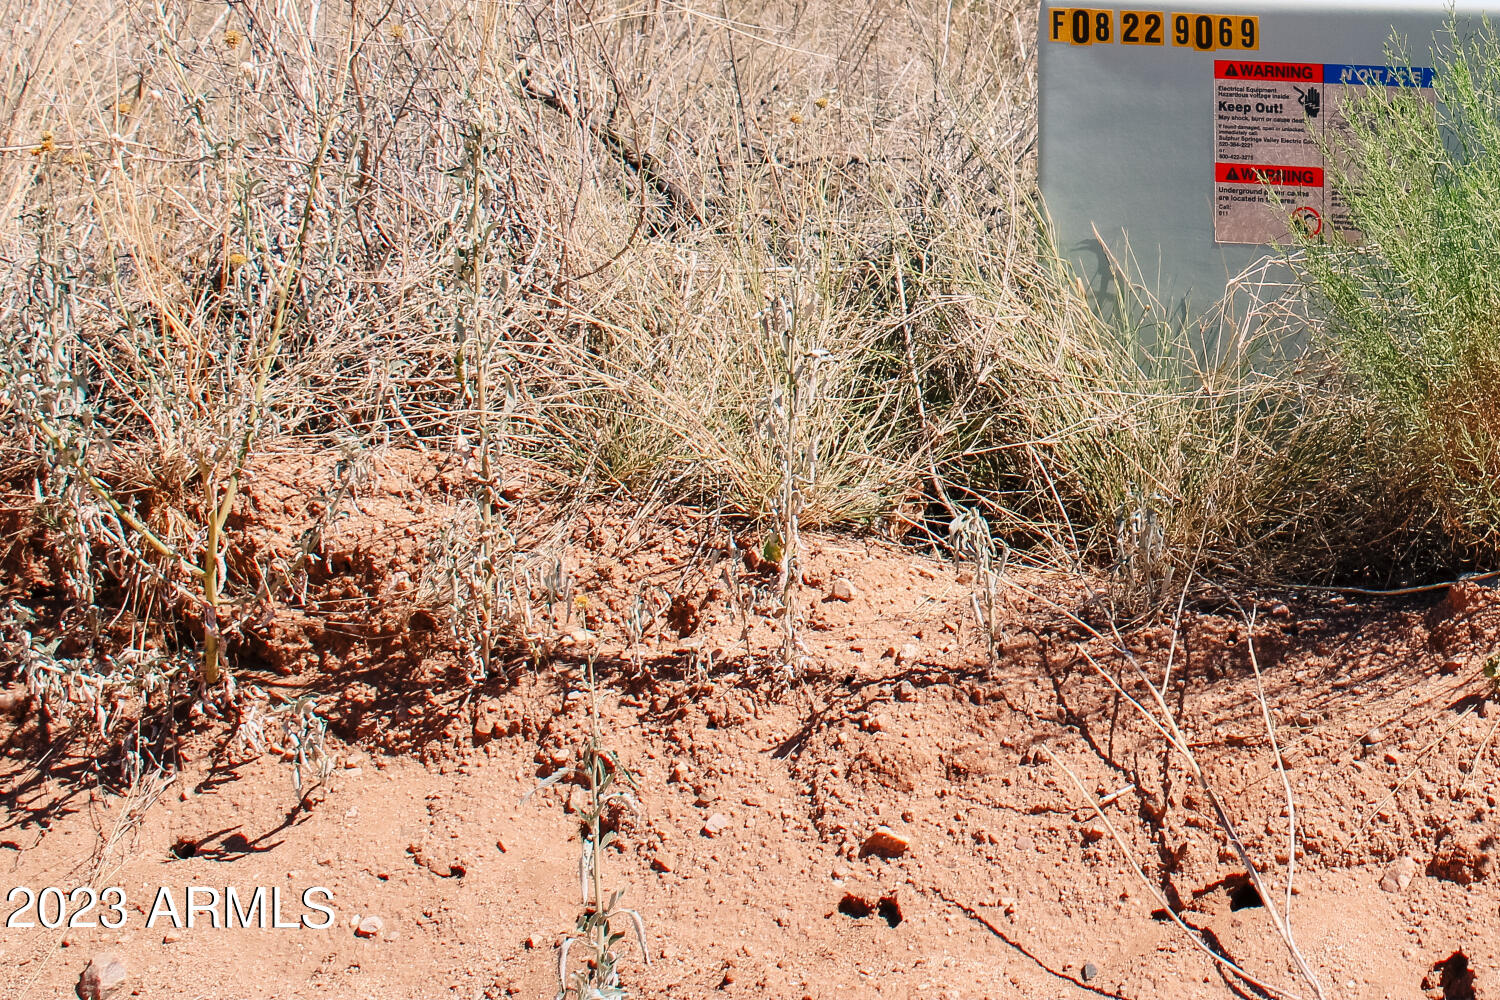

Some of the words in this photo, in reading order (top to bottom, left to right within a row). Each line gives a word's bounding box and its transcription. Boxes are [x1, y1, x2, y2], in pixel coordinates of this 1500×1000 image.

[1052, 10, 1110, 44] F08
[1122, 13, 1161, 44] 22
[1175, 15, 1255, 50] 9069
[1239, 64, 1313, 79] WARNING
[1218, 101, 1251, 115] Keep
[1255, 102, 1283, 114] Out!
[1240, 167, 1314, 184] WARNING
[1218, 186, 1263, 196] Underground
